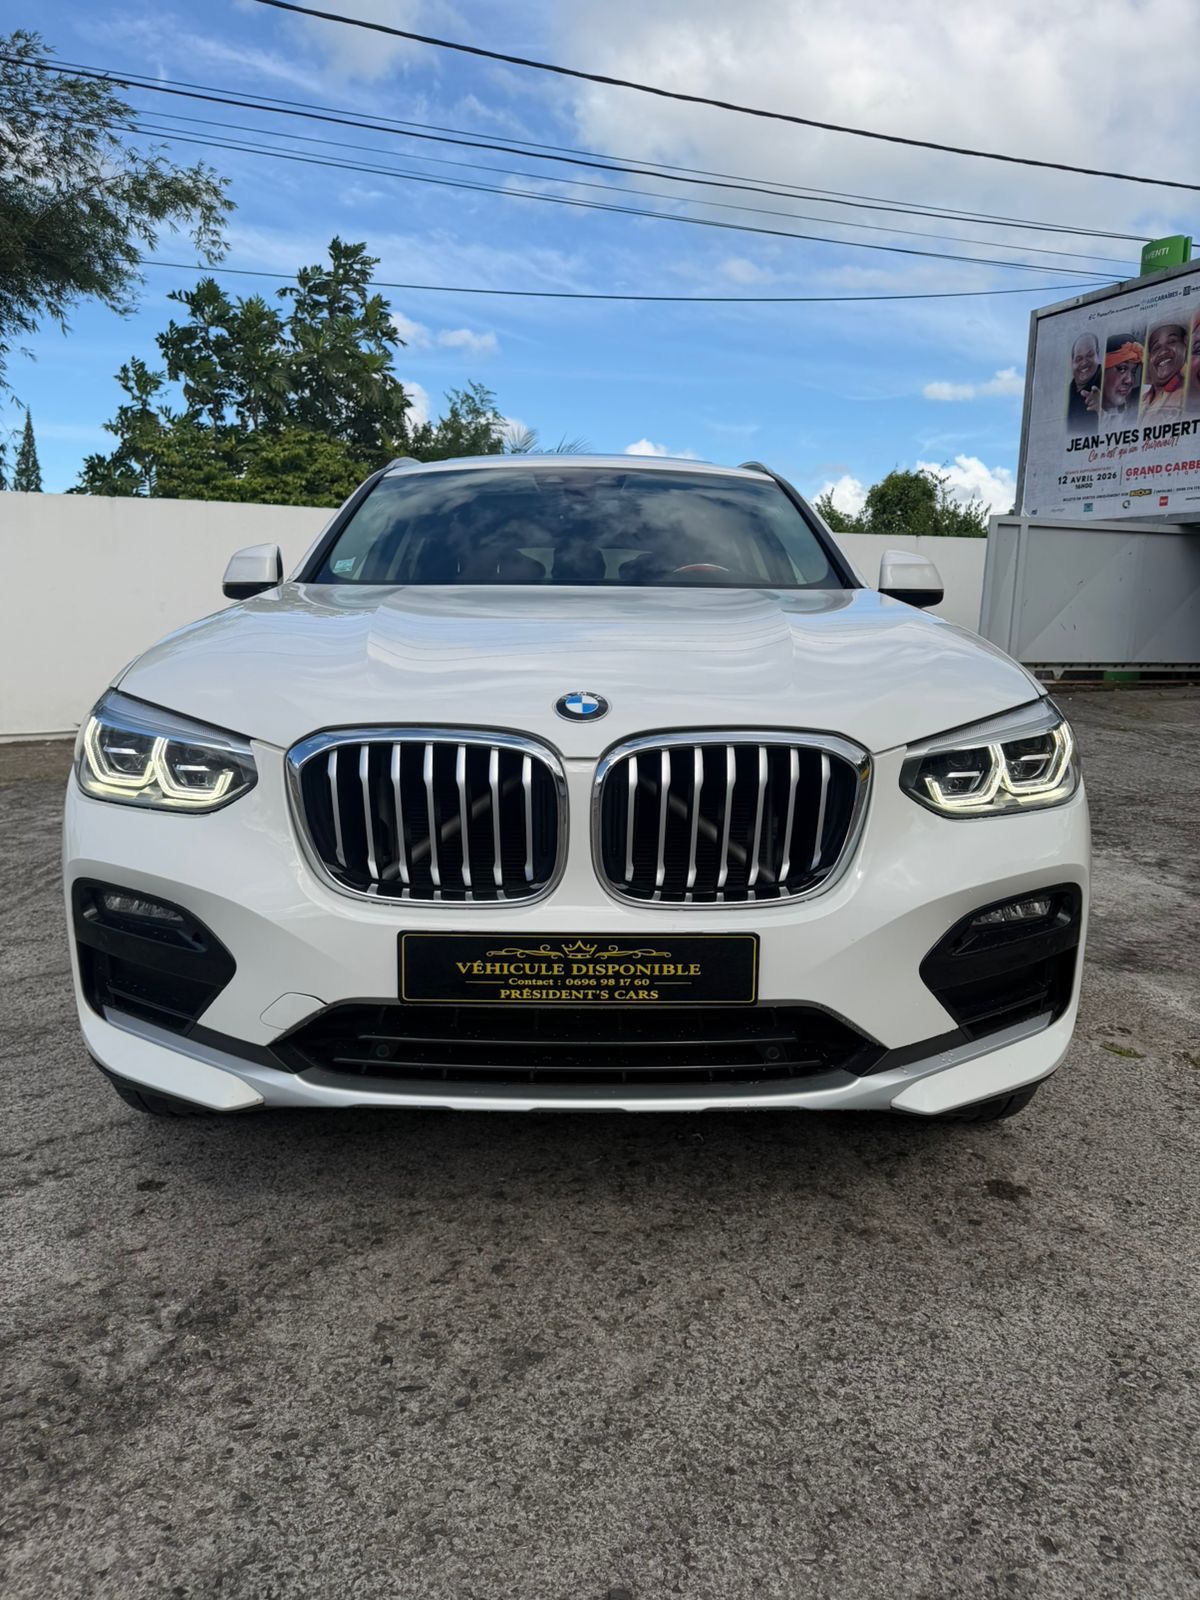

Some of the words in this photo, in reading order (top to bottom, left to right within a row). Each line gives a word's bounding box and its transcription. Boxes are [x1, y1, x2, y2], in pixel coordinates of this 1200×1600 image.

[1066, 429, 1139, 452] JEAN-YVES
[1143, 419, 1200, 441] RUPERT
[1126, 465, 1162, 477] GRAND
[1058, 476, 1068, 485] 12
[1070, 475, 1093, 484] AVRIL
[1097, 472, 1117, 480] 2026
[456, 960, 565, 975] VÉHICULE
[571, 963, 701, 976] DISPONIBLE
[508, 978, 554, 986] Contact
[566, 978, 597, 986] 0696
[600, 978, 616, 986] 98
[619, 978, 632, 986] 17
[634, 978, 650, 986] 60
[500, 988, 609, 999] PRÉSIDENT'S
[614, 990, 659, 999] CARS
